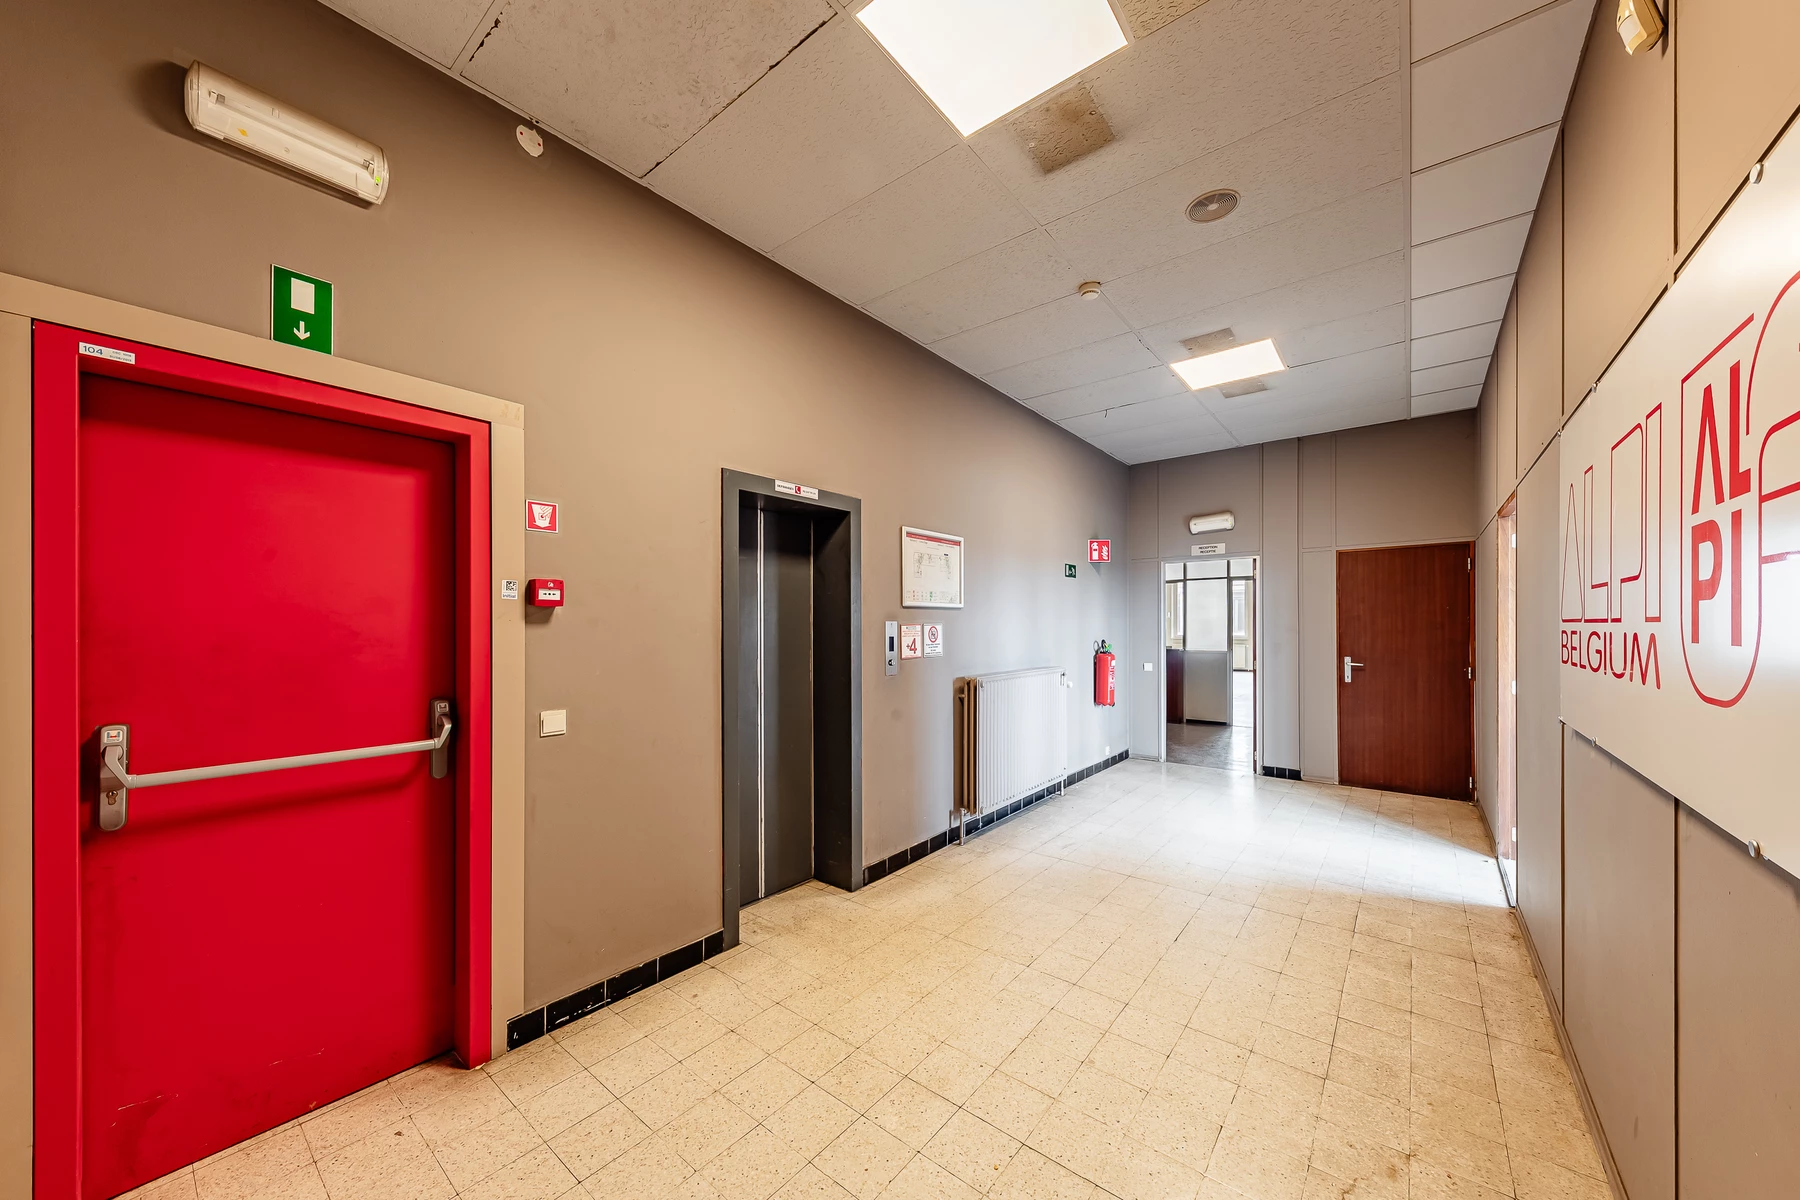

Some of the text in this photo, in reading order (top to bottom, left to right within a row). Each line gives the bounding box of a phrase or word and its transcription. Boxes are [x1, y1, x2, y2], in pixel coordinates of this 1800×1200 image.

[82, 345, 103, 356] 104
[1560, 402, 1662, 624] ALPI
[1691, 508, 1743, 648] PI
[1560, 629, 1662, 691] BELGIUM
